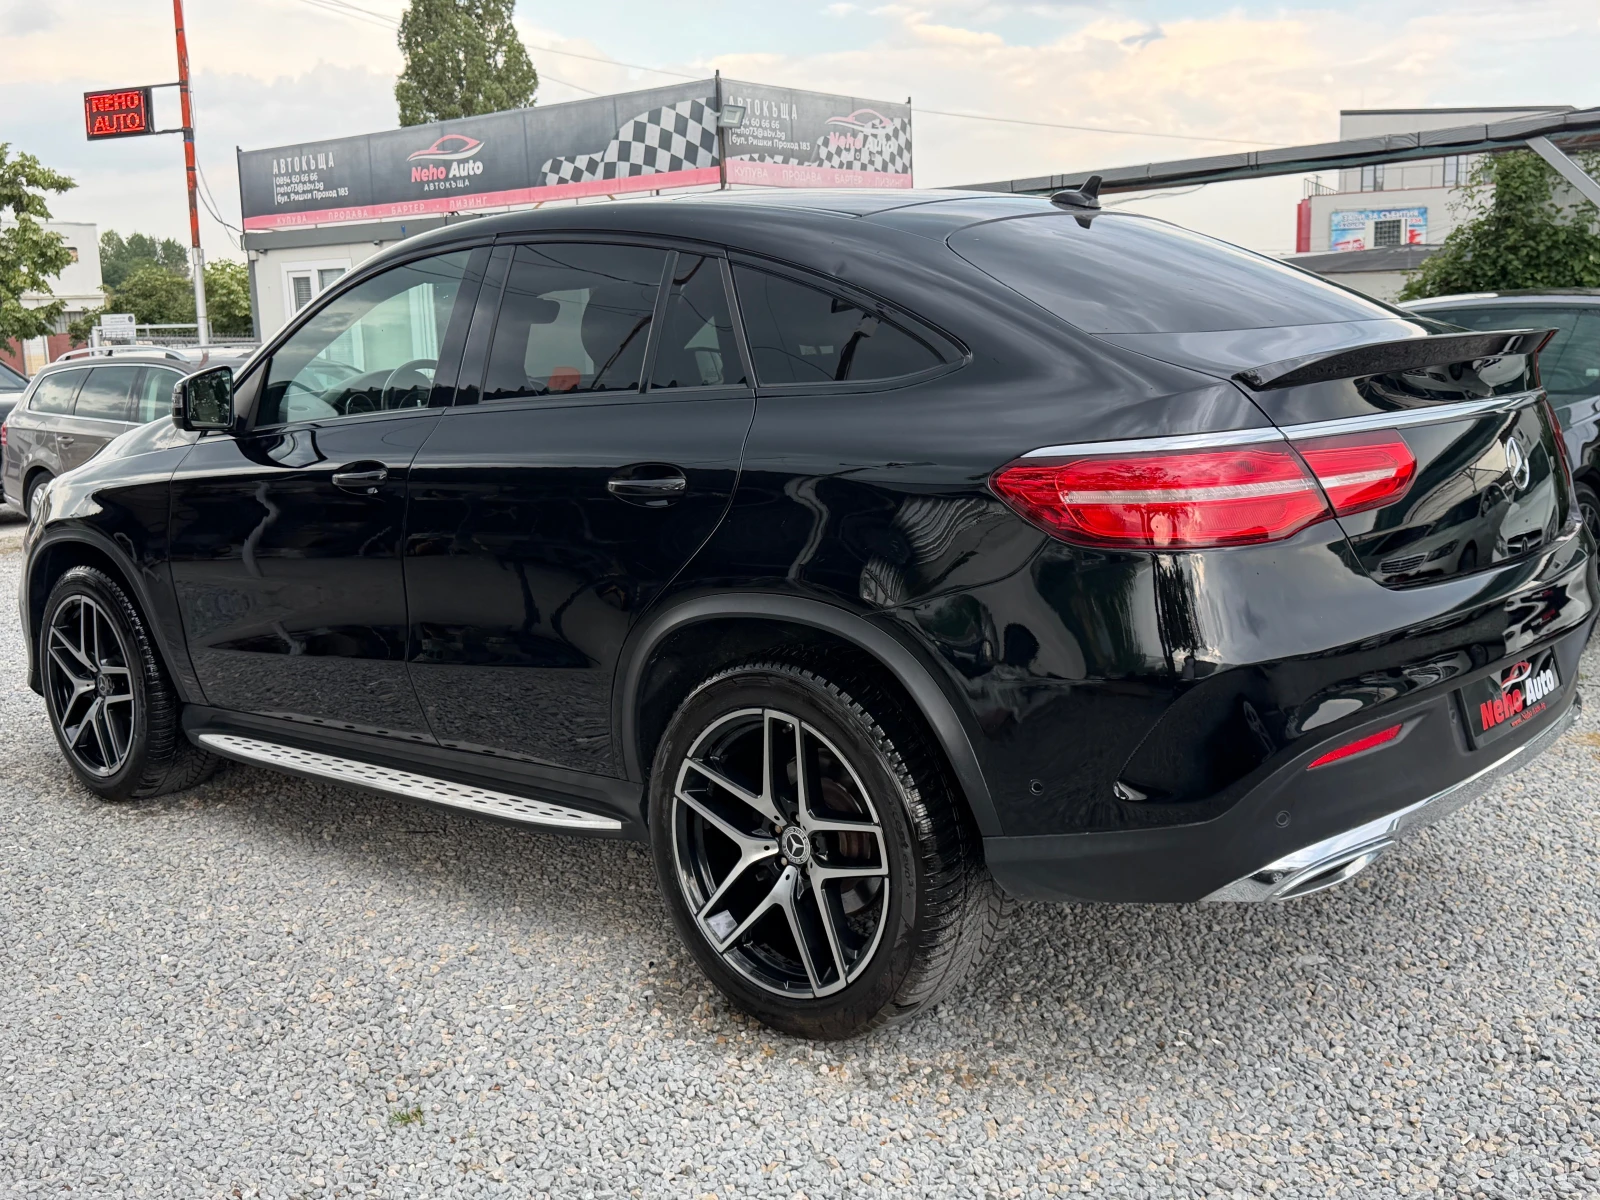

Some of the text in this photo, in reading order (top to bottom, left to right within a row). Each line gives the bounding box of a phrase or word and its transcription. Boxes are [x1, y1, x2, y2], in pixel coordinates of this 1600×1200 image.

[92, 94, 138, 112] NEHO
[94, 113, 139, 132] AUTO
[751, 118, 760, 127] 60
[761, 119, 770, 128] 66
[771, 120, 780, 129] 66
[748, 136, 773, 147] Ришки
[773, 139, 799, 151] Проход
[799, 141, 811, 151] 183
[829, 131, 895, 152] Neho Auto
[273, 151, 335, 175] АВТОКЪЩА
[411, 159, 484, 183] Neho Auto
[292, 174, 300, 183] 60
[301, 173, 309, 182] 66
[310, 172, 318, 181] 66
[423, 179, 470, 192] АВТОКЪЩА
[276, 181, 324, 193] neho73@abv.bg
[290, 192, 312, 202] Ришки
[313, 189, 338, 200] Проход
[338, 187, 349, 196] 183
[276, 215, 307, 225] КУПУВА
[328, 209, 369, 220] ПРОДАВА
[391, 203, 425, 215] БАРТЕР
[1481, 689, 1523, 730] Neho
[1525, 669, 1554, 706] Auto
